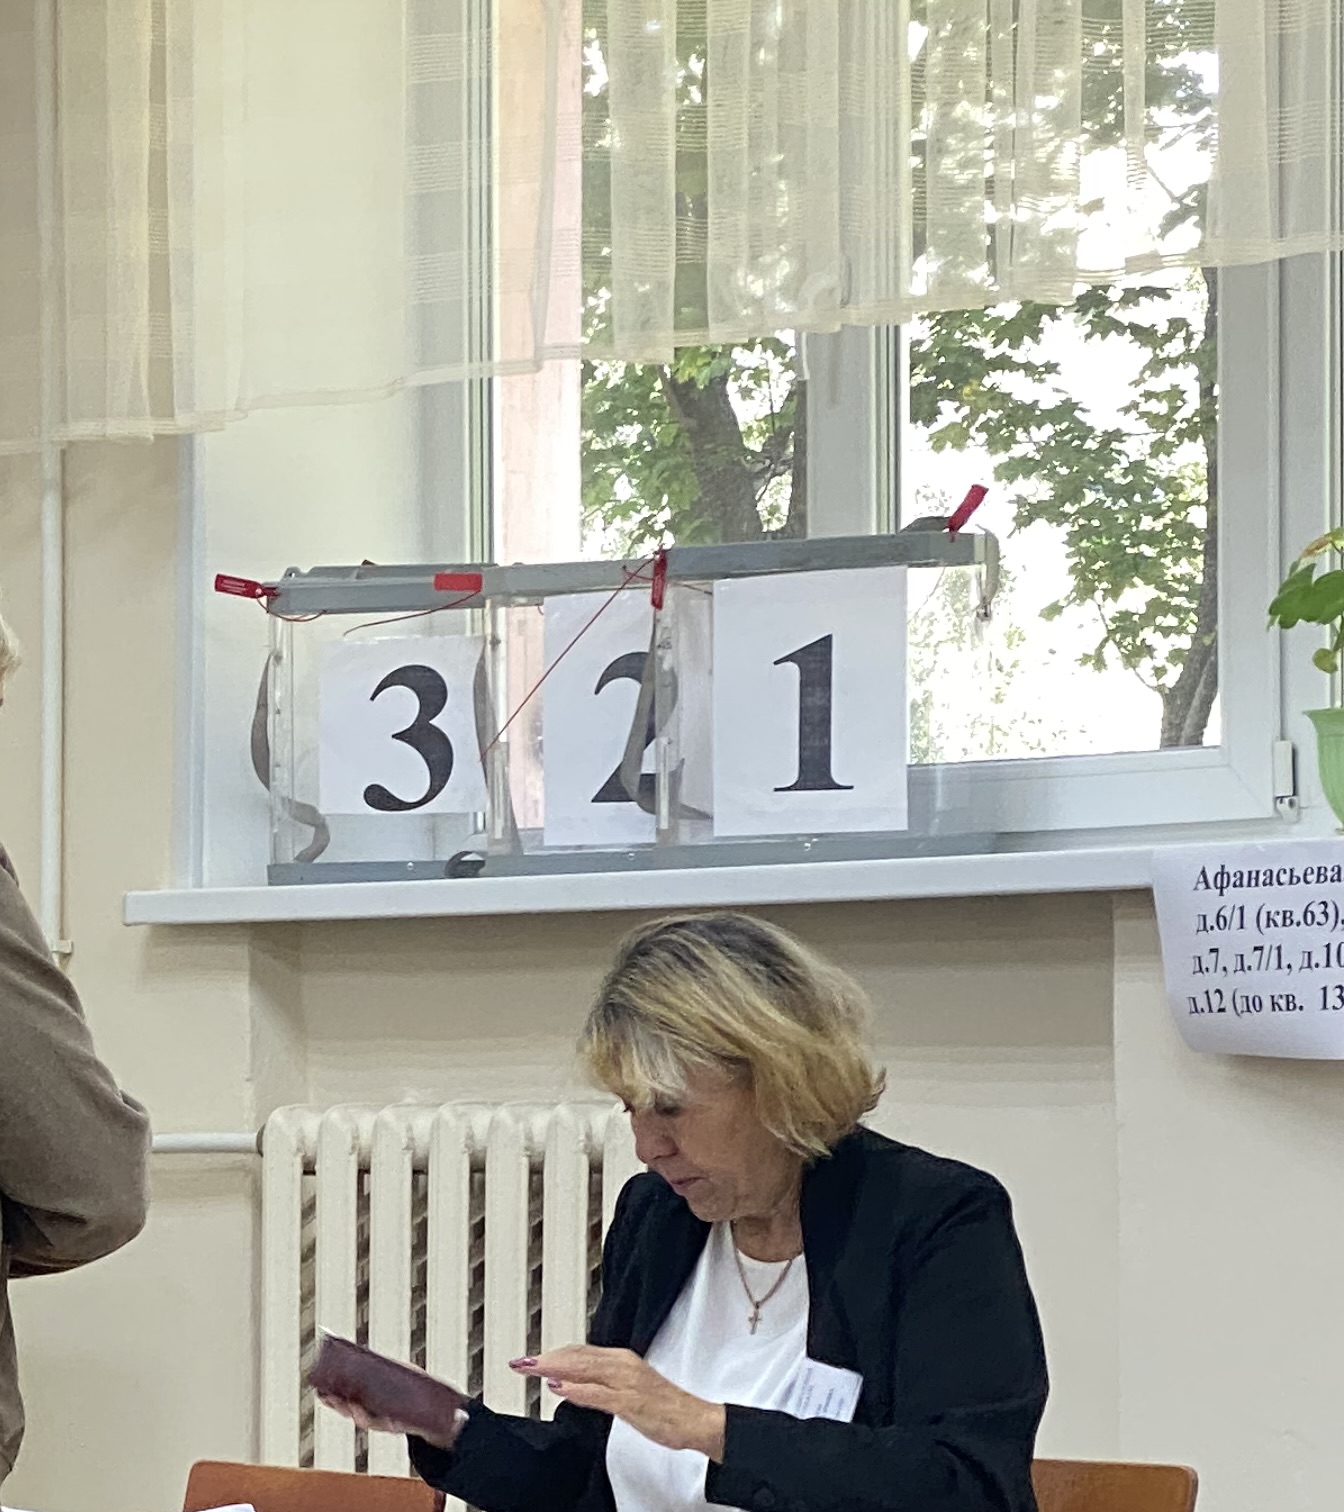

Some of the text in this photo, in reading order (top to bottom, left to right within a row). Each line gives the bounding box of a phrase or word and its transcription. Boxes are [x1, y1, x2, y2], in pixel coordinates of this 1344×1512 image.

[362, 663, 454, 812] 3
[591, 651, 685, 804] 2
[772, 633, 855, 793] 1
[1192, 947, 1228, 977] д.7,
[1233, 943, 1292, 977] д.7/1,
[1195, 903, 1247, 935] д.6/1
[1187, 983, 1344, 1018] д.12 (до кв. 13
